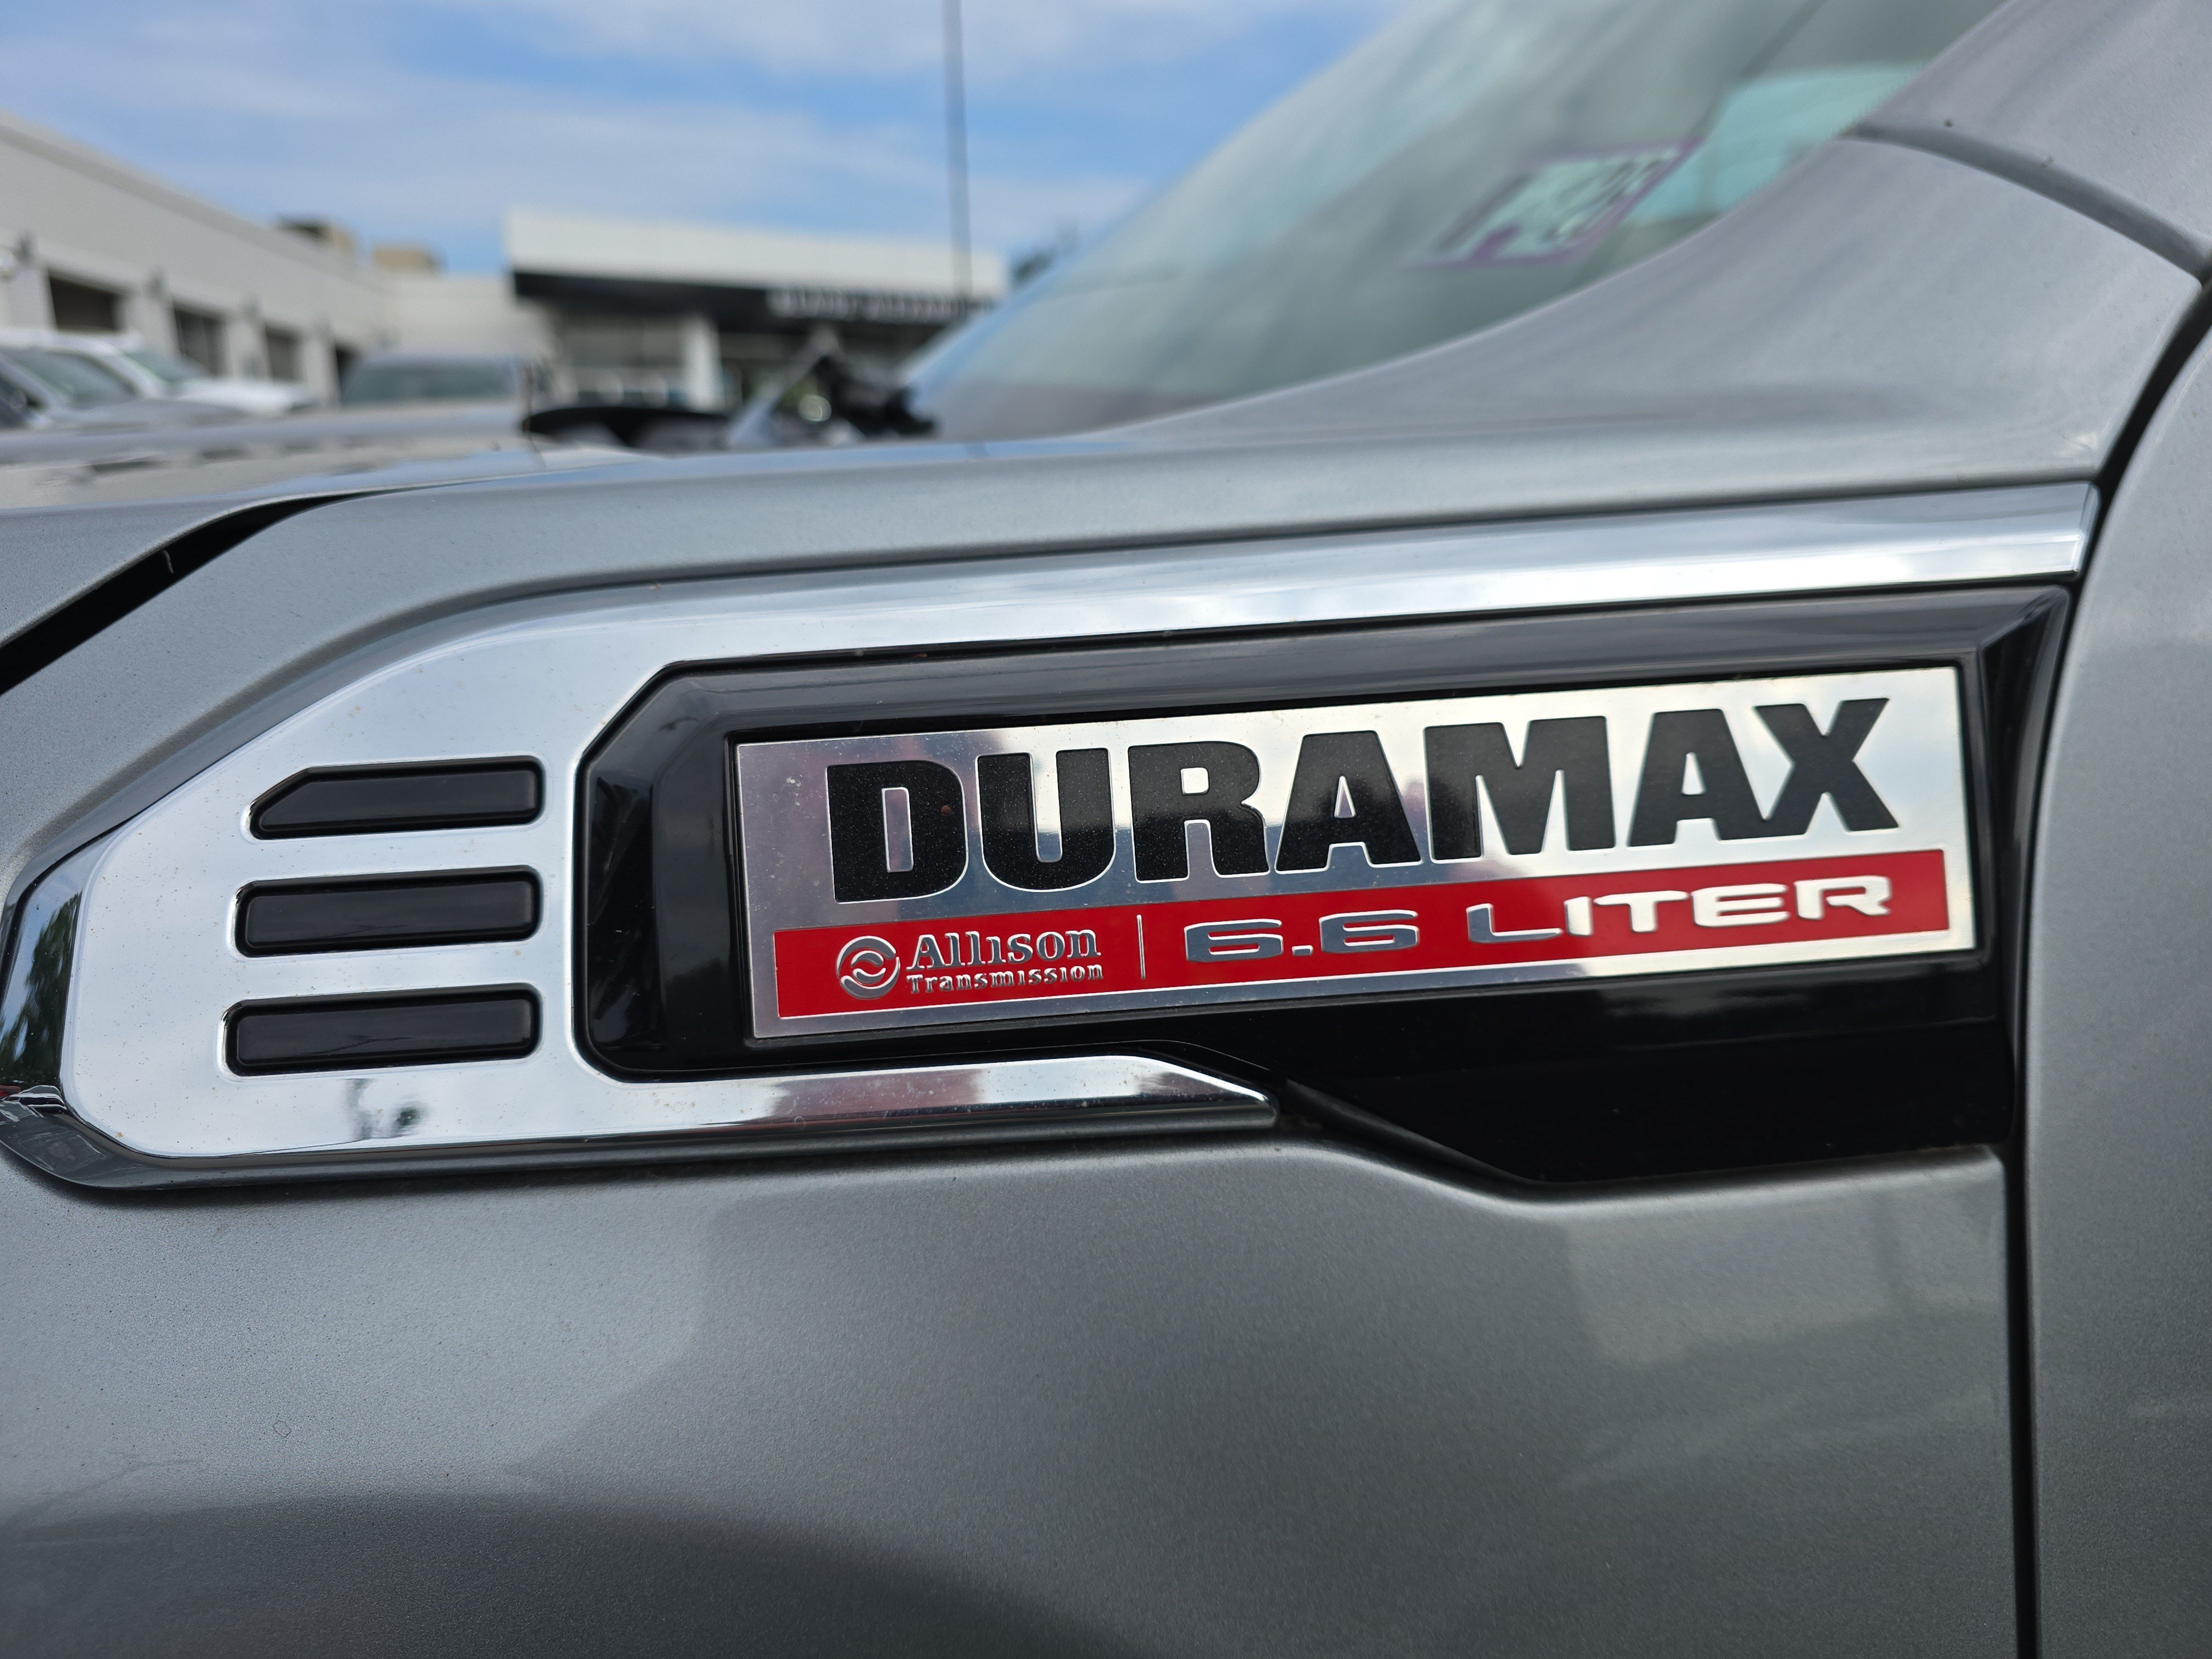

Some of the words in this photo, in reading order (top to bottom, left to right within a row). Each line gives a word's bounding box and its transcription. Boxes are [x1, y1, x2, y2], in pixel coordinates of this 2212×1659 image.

[826, 697, 1900, 904] DURAMAX
[905, 929, 1102, 971] Allison
[1184, 909, 1420, 963] 6.6
[1465, 874, 1892, 944] LITER
[906, 963, 1104, 995] Transmission
